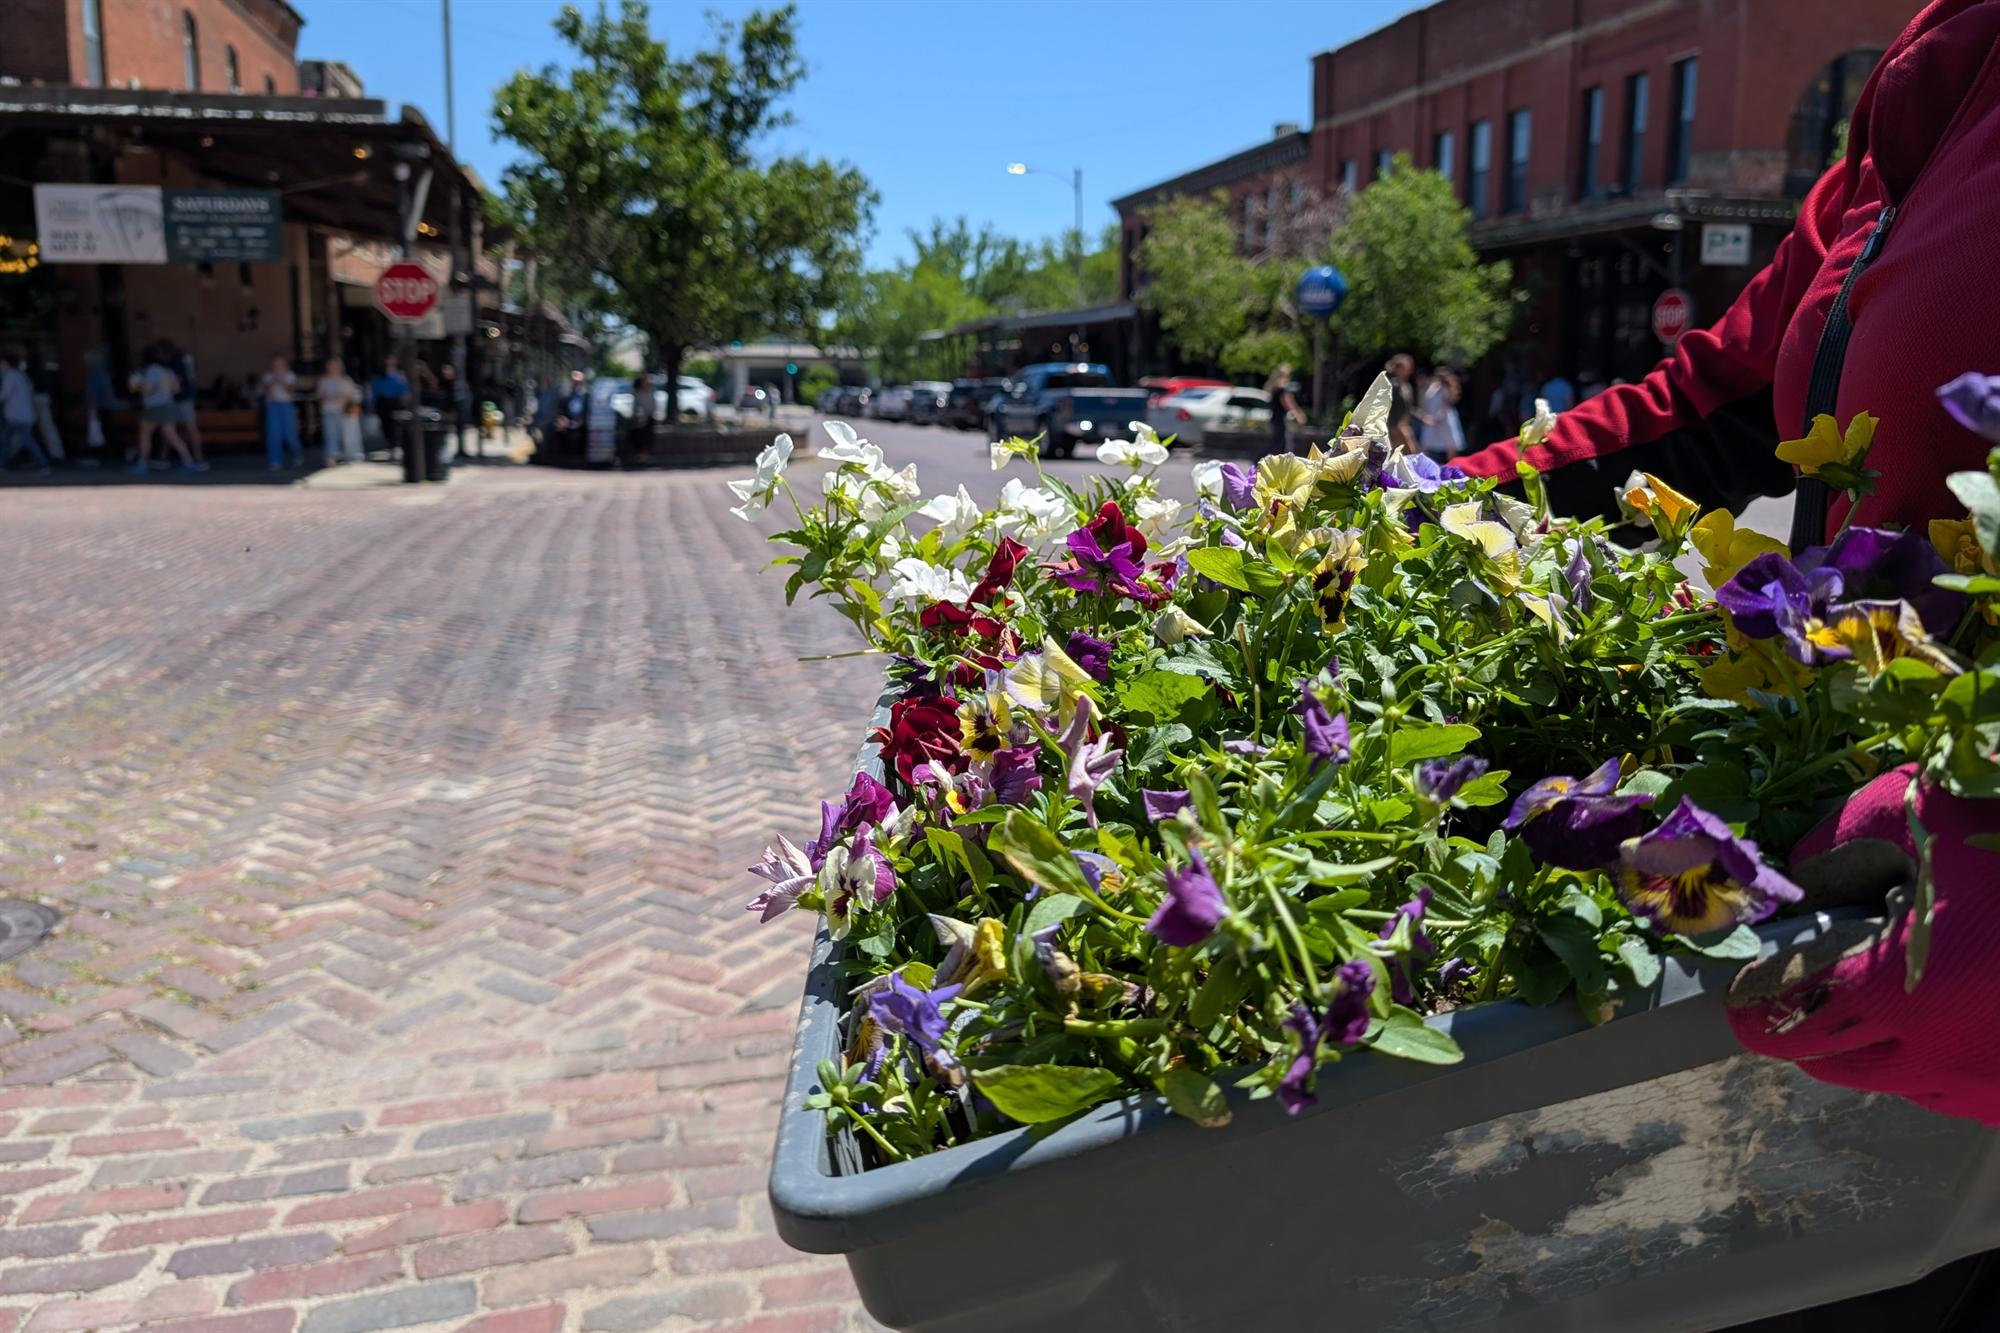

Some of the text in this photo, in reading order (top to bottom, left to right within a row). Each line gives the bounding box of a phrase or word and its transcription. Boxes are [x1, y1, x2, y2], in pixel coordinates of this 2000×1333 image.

[173, 196, 270, 212] SATURDAYS
[380, 278, 437, 304] STOP
[1655, 304, 1687, 327] STOP
